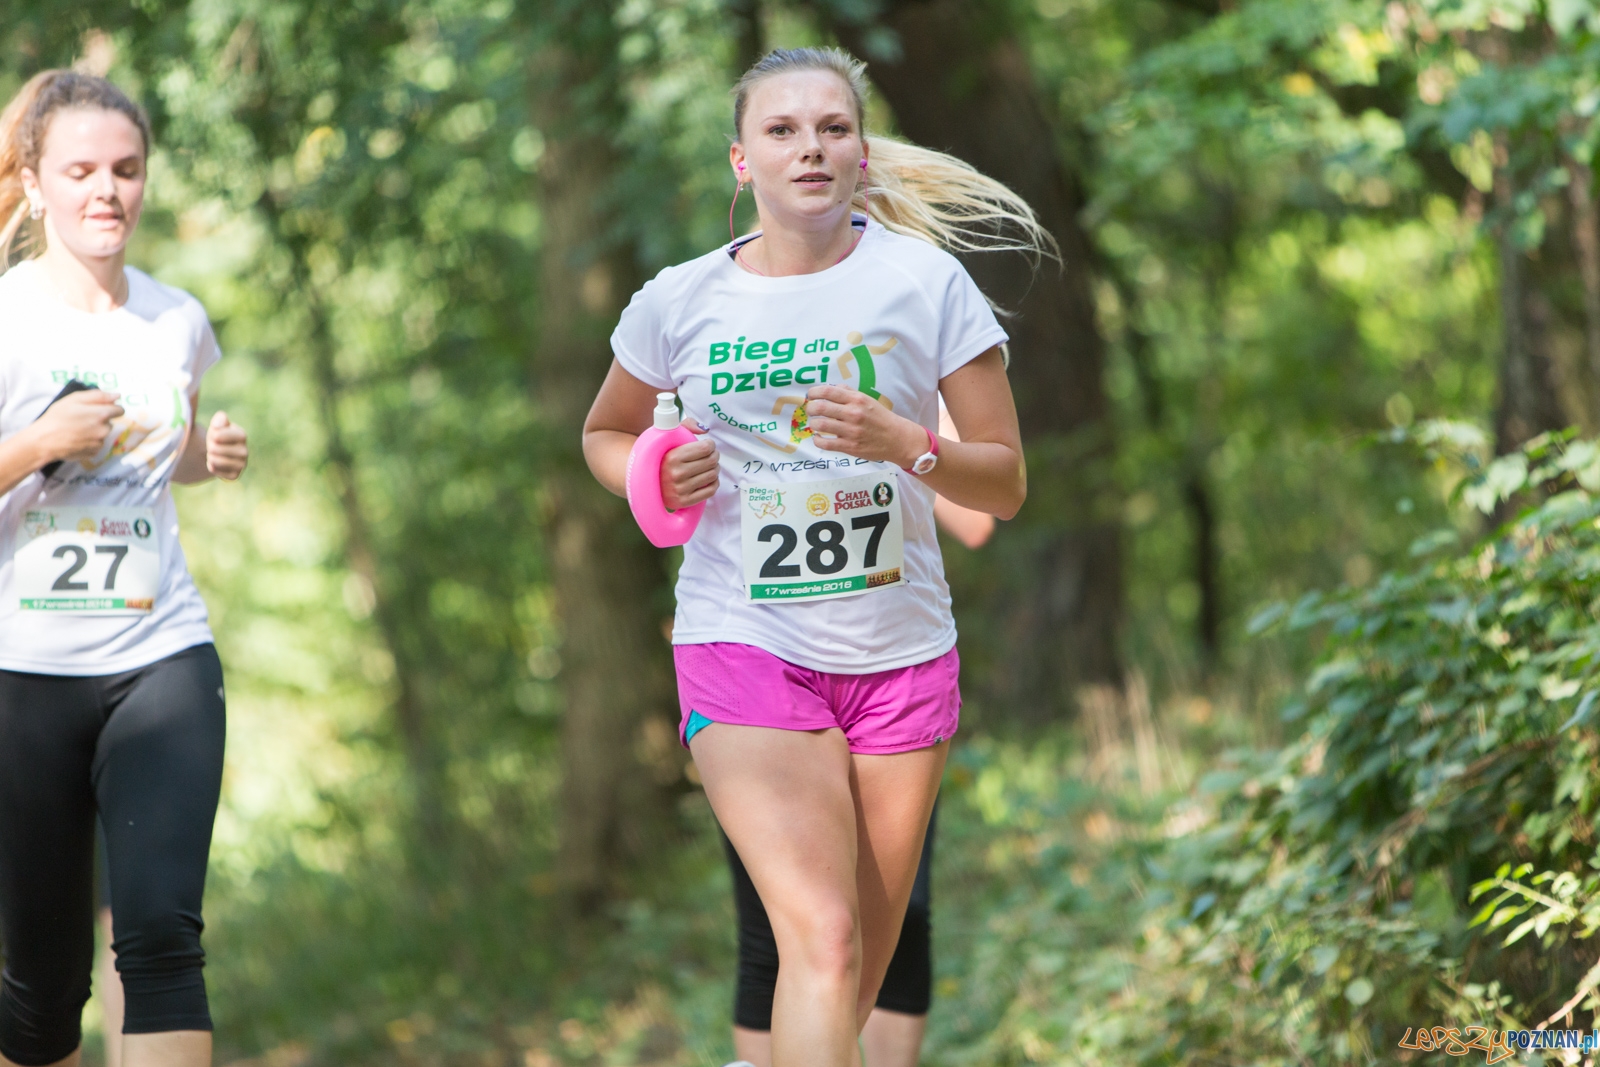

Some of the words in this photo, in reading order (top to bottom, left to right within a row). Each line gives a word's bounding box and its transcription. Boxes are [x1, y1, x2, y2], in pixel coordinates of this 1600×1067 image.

[708, 336, 797, 366] Bieg
[803, 338, 839, 354] dla
[710, 356, 831, 396] Dzieci
[708, 402, 778, 433] Roberta
[748, 486, 767, 495] Bieg
[834, 489, 870, 503] CHATA
[833, 498, 873, 515] POLSKA
[757, 511, 890, 579] 287
[50, 544, 129, 591] 27
[764, 587, 779, 596] 17
[822, 580, 853, 592] 2016
